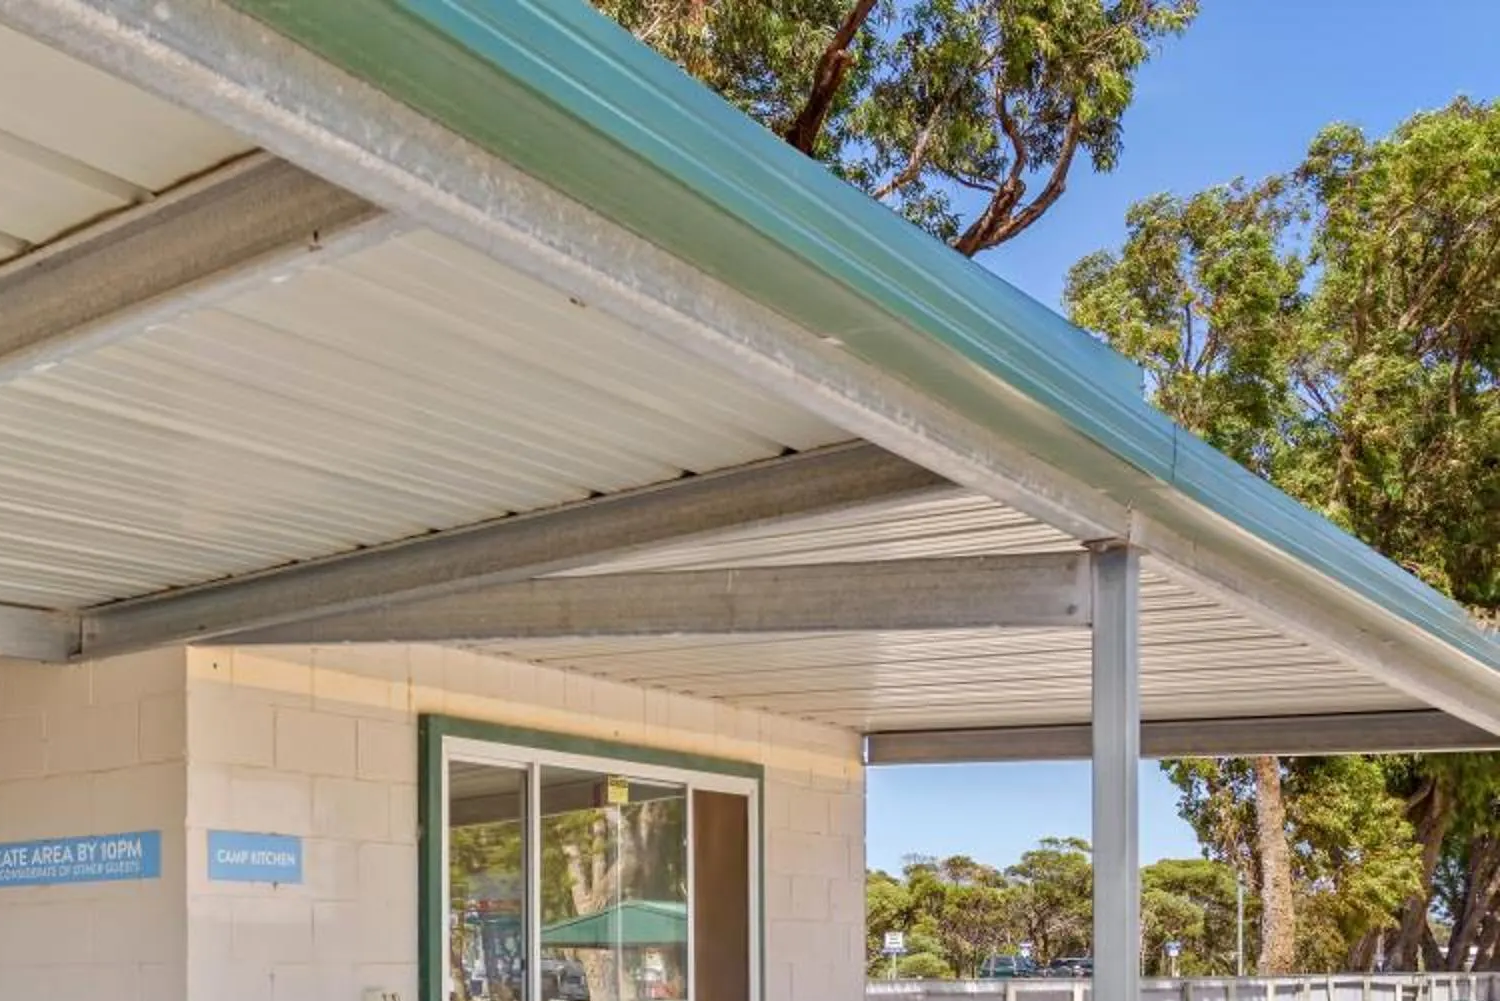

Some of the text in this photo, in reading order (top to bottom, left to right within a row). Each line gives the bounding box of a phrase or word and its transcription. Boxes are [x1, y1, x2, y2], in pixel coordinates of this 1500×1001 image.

[31, 844, 74, 865] AREA
[77, 841, 98, 862] BY
[100, 838, 143, 861] 10PM
[217, 848, 296, 867] CAMP KITCHEN
